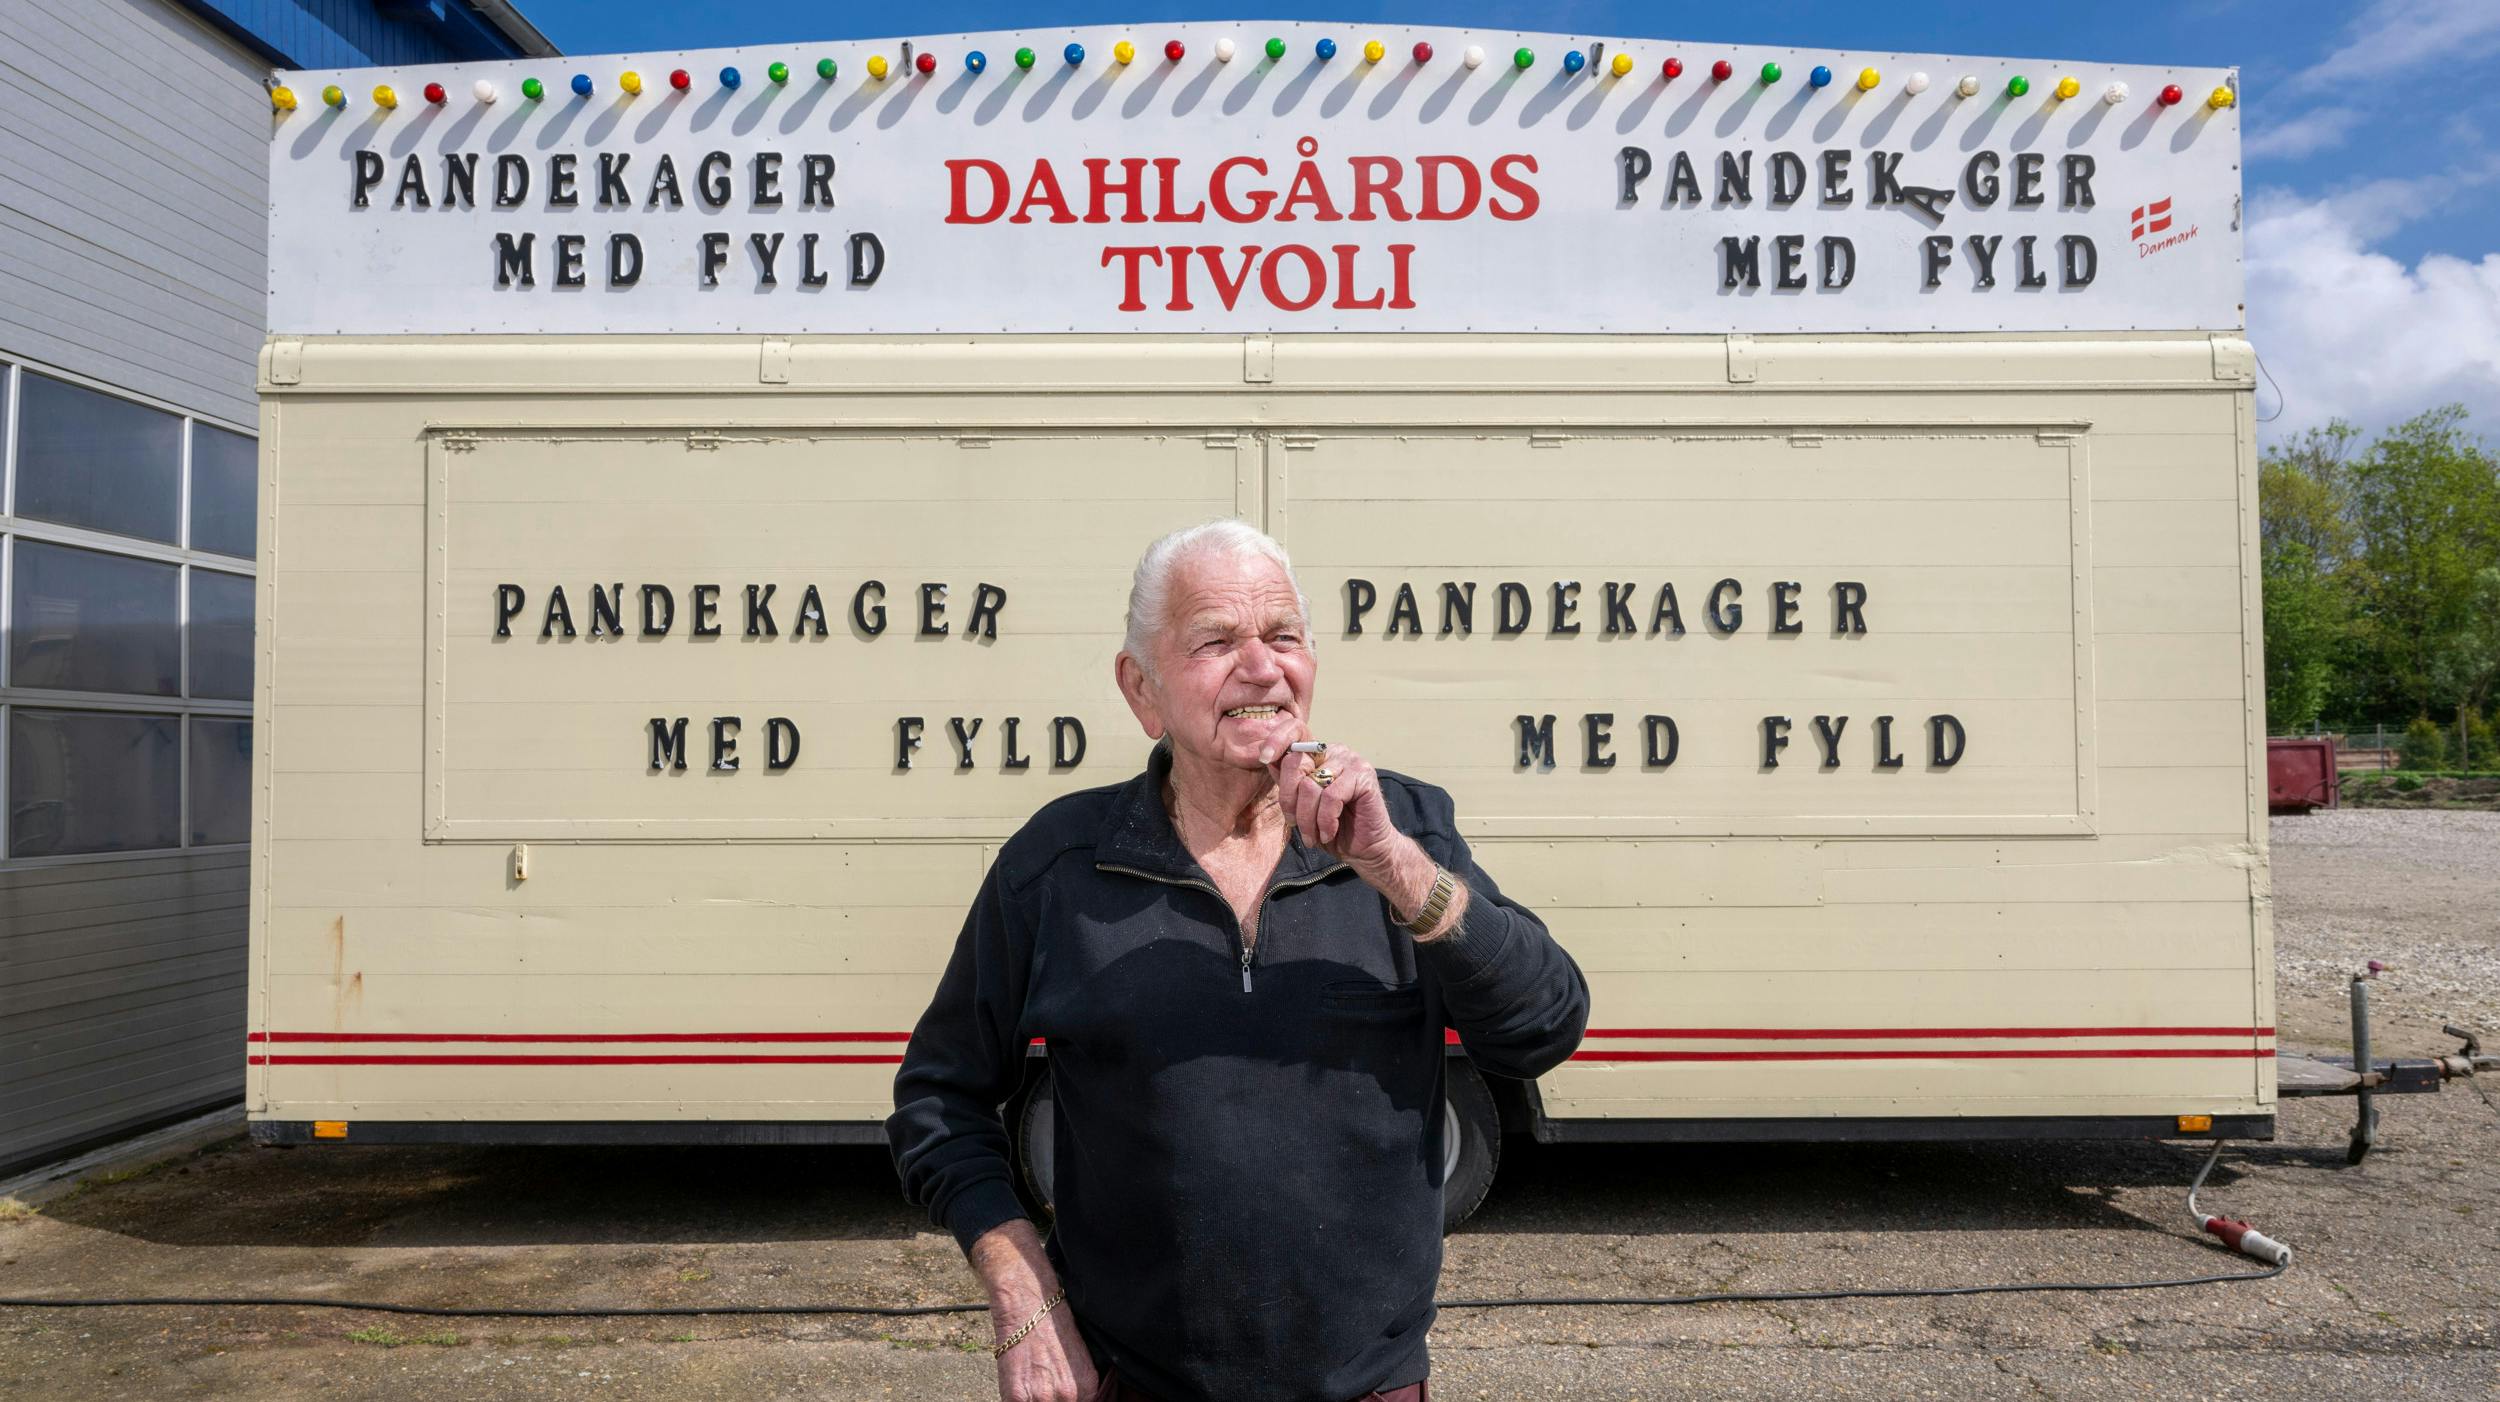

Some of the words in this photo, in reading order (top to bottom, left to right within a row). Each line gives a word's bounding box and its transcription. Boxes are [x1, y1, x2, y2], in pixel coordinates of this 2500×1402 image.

[355, 151, 834, 207] PANDEKAGER
[945, 137, 1538, 224] DAHLGÅRDS
[1623, 148, 2094, 221] PANDEKAGER
[496, 234, 642, 286] MED
[703, 233, 884, 285] FYLD
[1723, 236, 1854, 288] MED
[1927, 236, 2096, 286] FYLD
[2138, 224, 2199, 259] Danmark
[1102, 245, 1414, 311] TIVOLI
[497, 581, 1006, 639] PANDEKAGER
[1348, 579, 1866, 634] PANDEKAGER
[651, 717, 799, 770] MED
[898, 717, 1086, 768] FYLD
[1518, 714, 1678, 767] MED
[1764, 715, 1965, 767] FYLD
